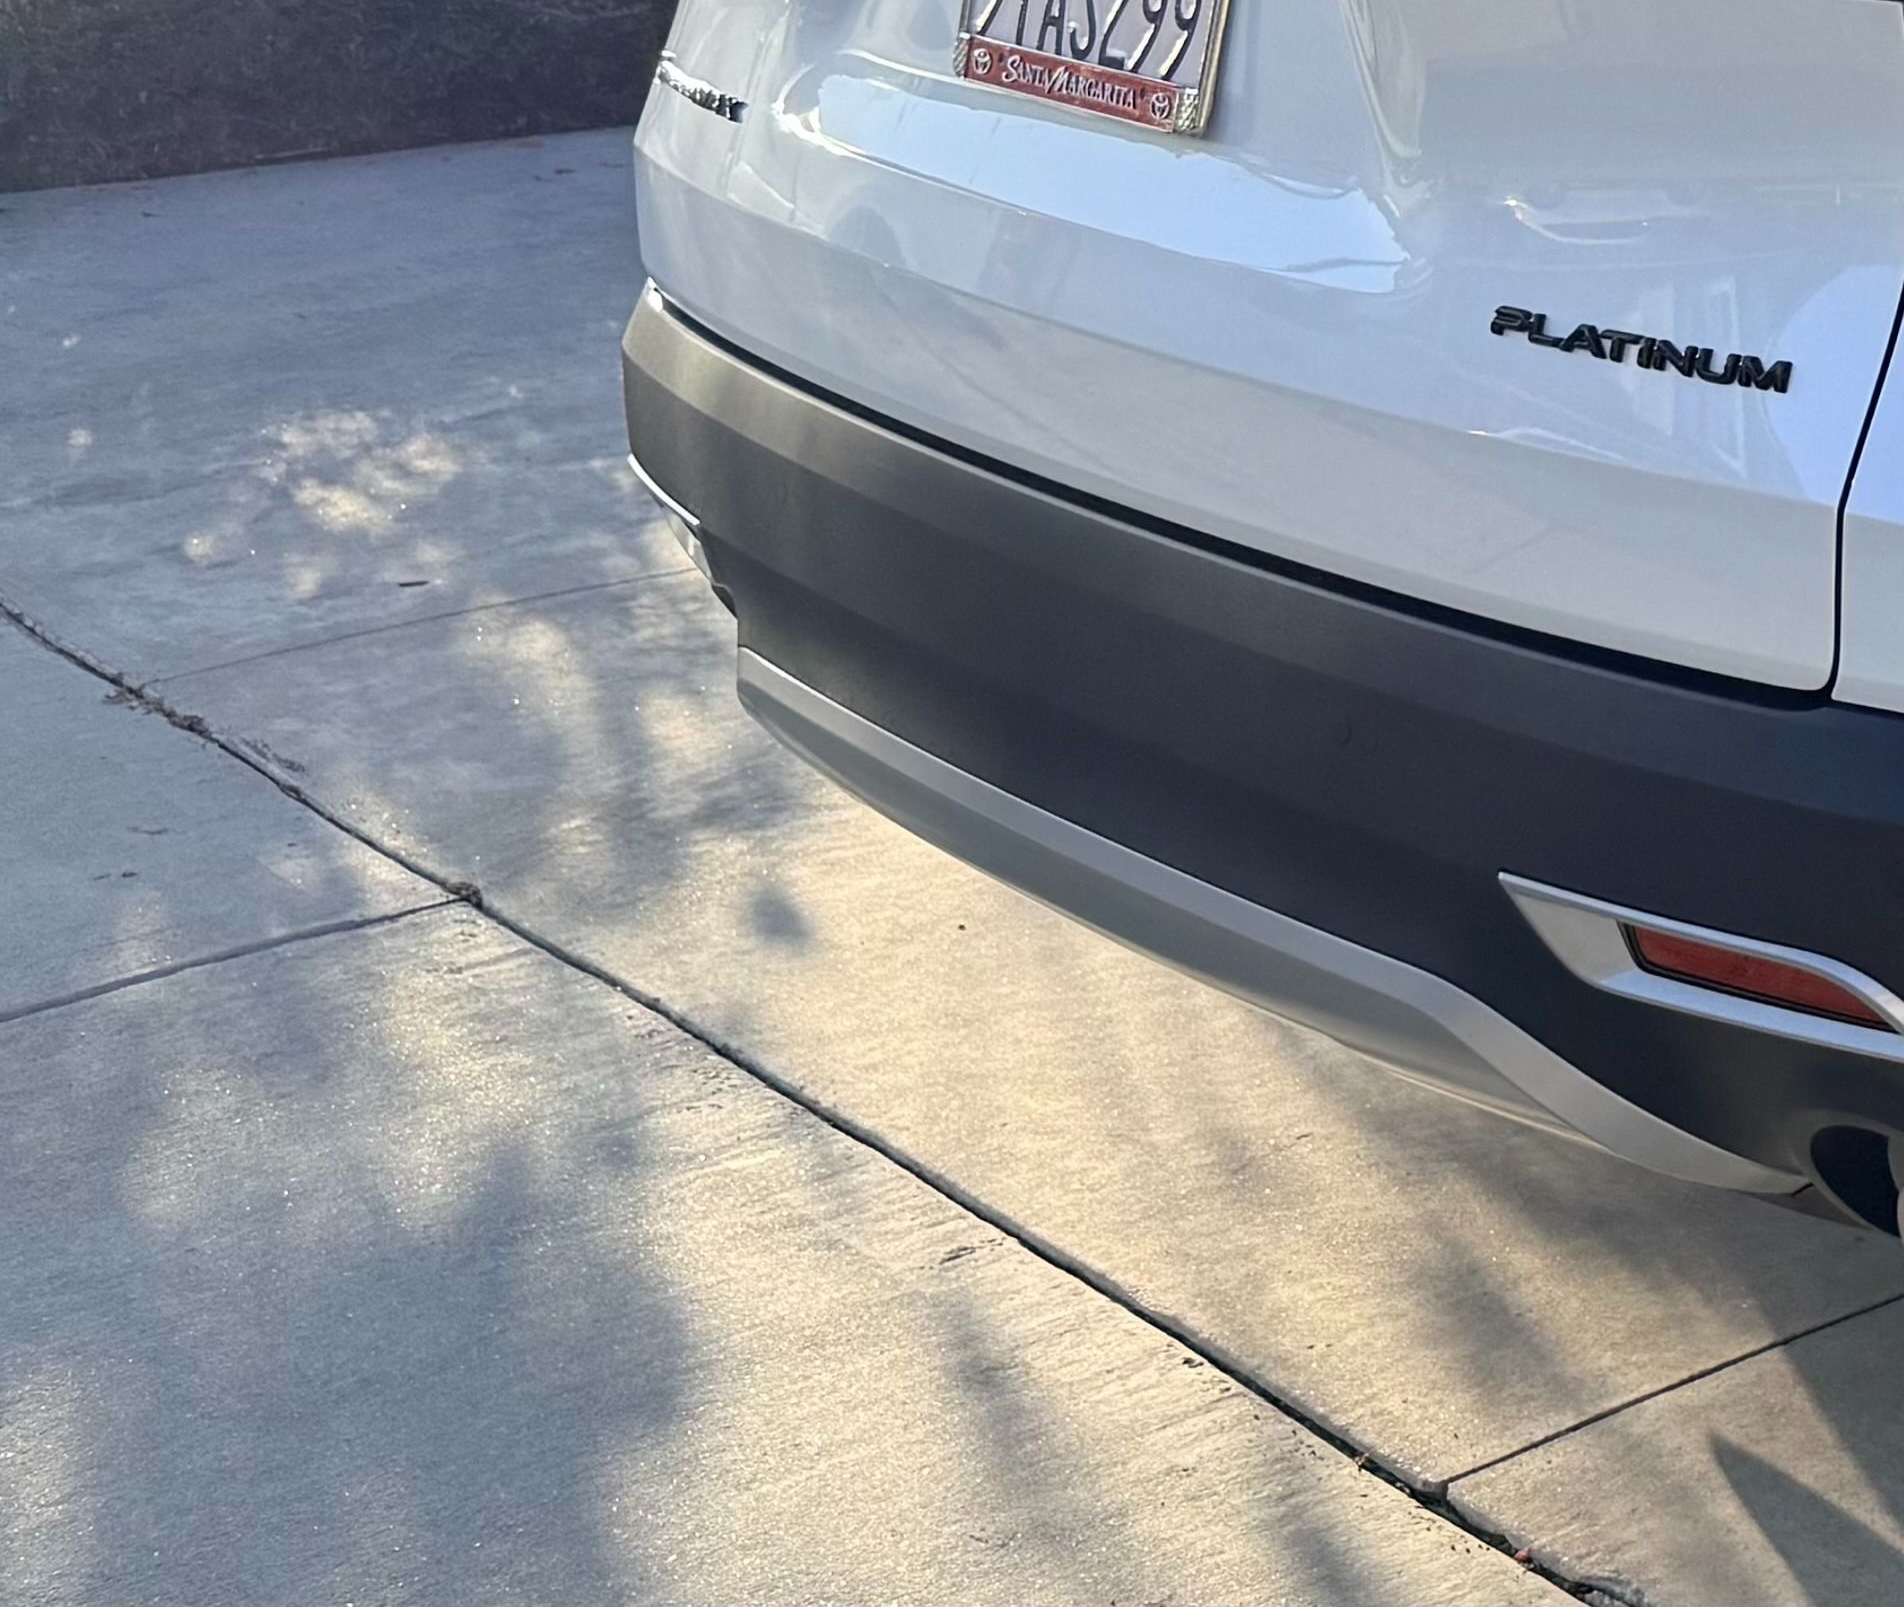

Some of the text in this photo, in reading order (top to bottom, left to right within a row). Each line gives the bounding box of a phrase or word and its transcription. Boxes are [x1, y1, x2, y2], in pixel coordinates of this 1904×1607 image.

[1001, 54, 1137, 110] SANTA MARGARITA
[1490, 305, 1794, 394] PLATINUM
